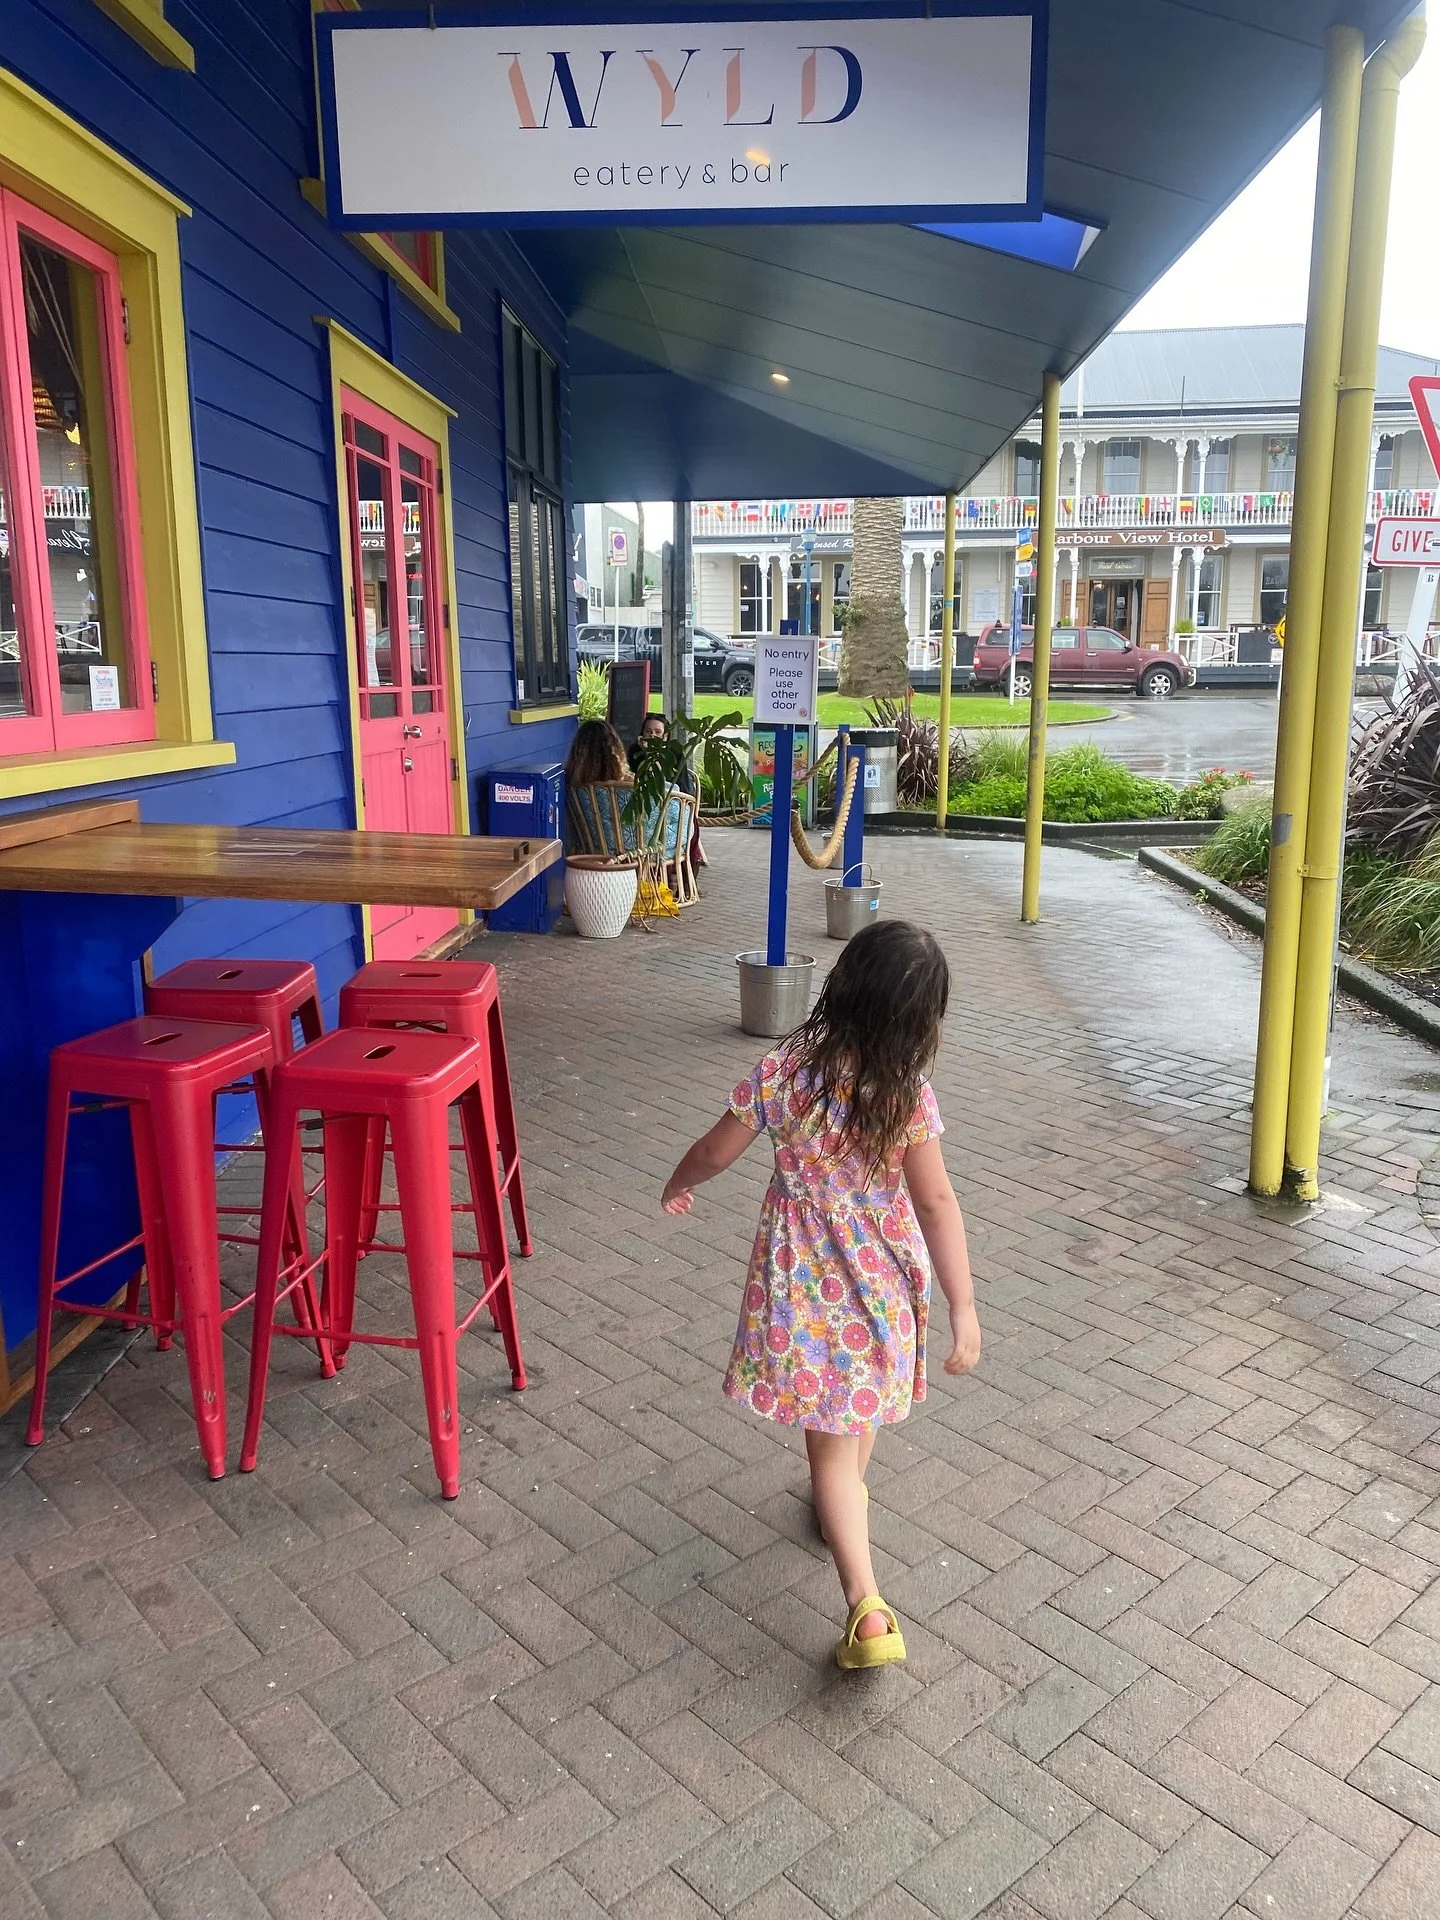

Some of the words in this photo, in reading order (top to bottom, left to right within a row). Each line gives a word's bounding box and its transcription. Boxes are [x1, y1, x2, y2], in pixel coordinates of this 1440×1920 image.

[498, 45, 863, 130] WYLD
[573, 160, 692, 190] eatery
[701, 163, 717, 185] &
[730, 157, 790, 184] bar
[796, 539, 839, 549] Lensed
[1055, 532, 1112, 545] arbour
[1117, 532, 1163, 544] View
[1168, 531, 1215, 543] Hotel
[1391, 529, 1434, 553] GIVE
[764, 648, 780, 658] No
[781, 650, 809, 661] entry
[769, 667, 803, 678] Please
[775, 680, 794, 688] use
[771, 690, 799, 699] other
[772, 700, 797, 709] door
